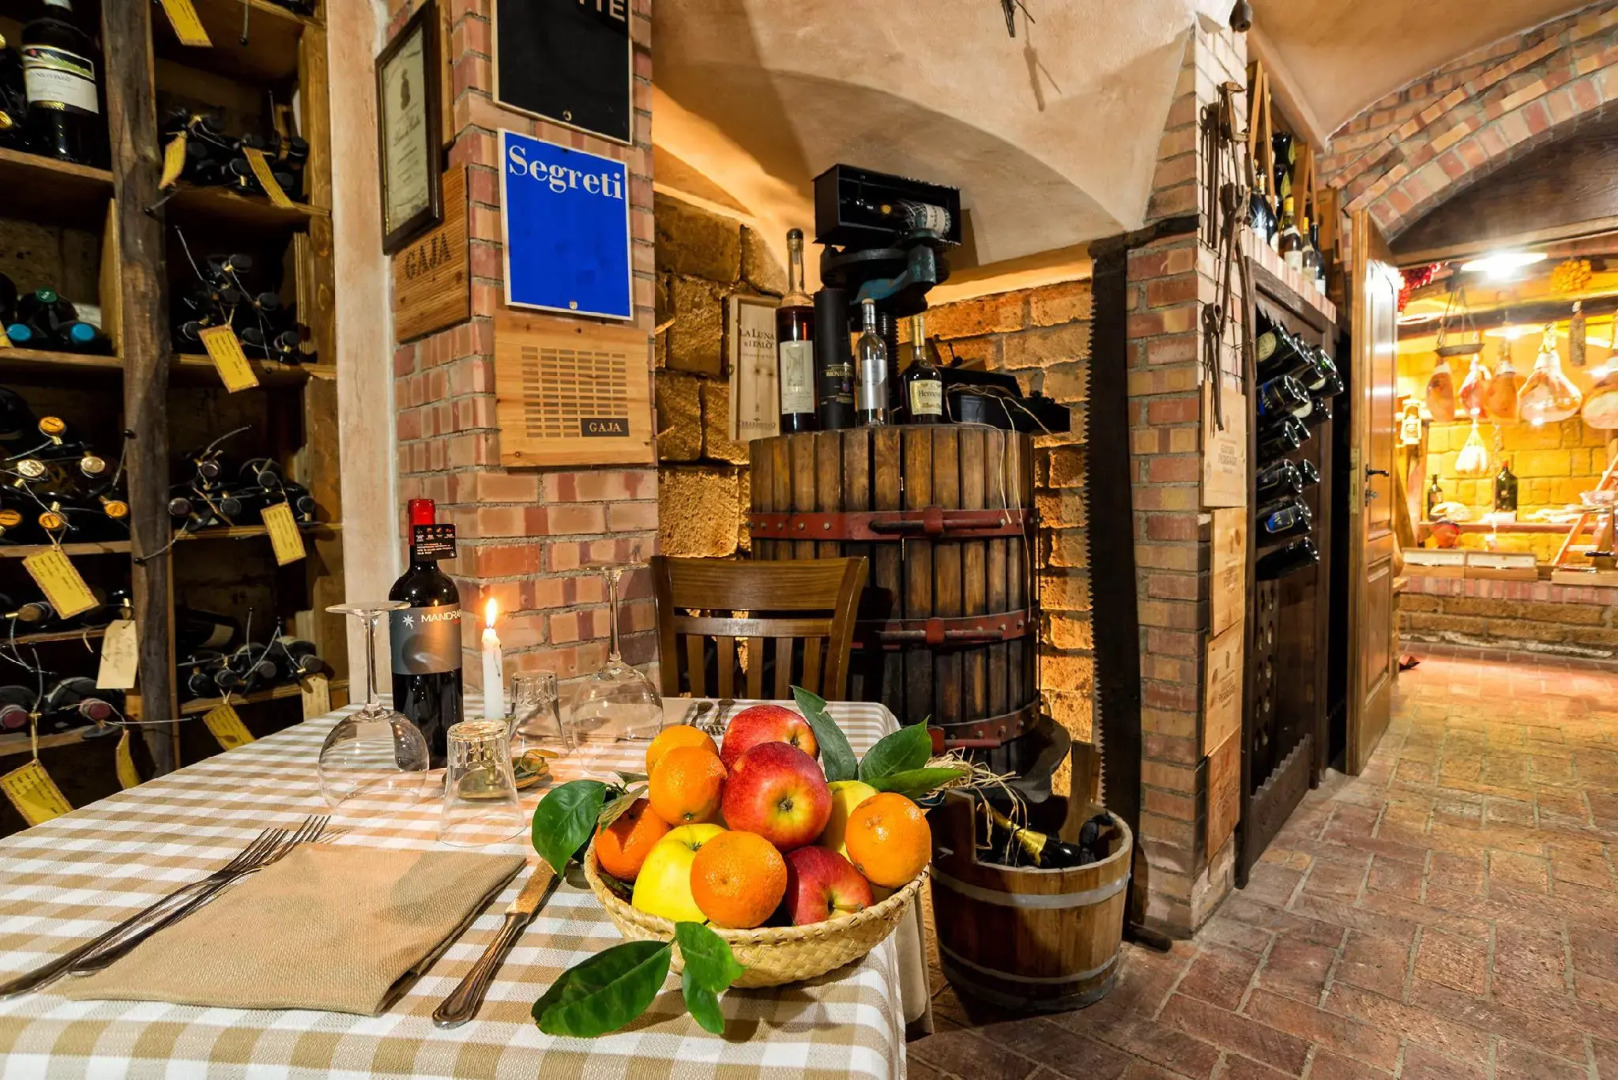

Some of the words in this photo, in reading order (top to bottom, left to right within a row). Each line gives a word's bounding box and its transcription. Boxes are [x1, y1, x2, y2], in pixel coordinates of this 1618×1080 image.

[509, 145, 623, 200] Segreti
[405, 232, 452, 281] GAJA
[589, 421, 623, 433] GAJA
